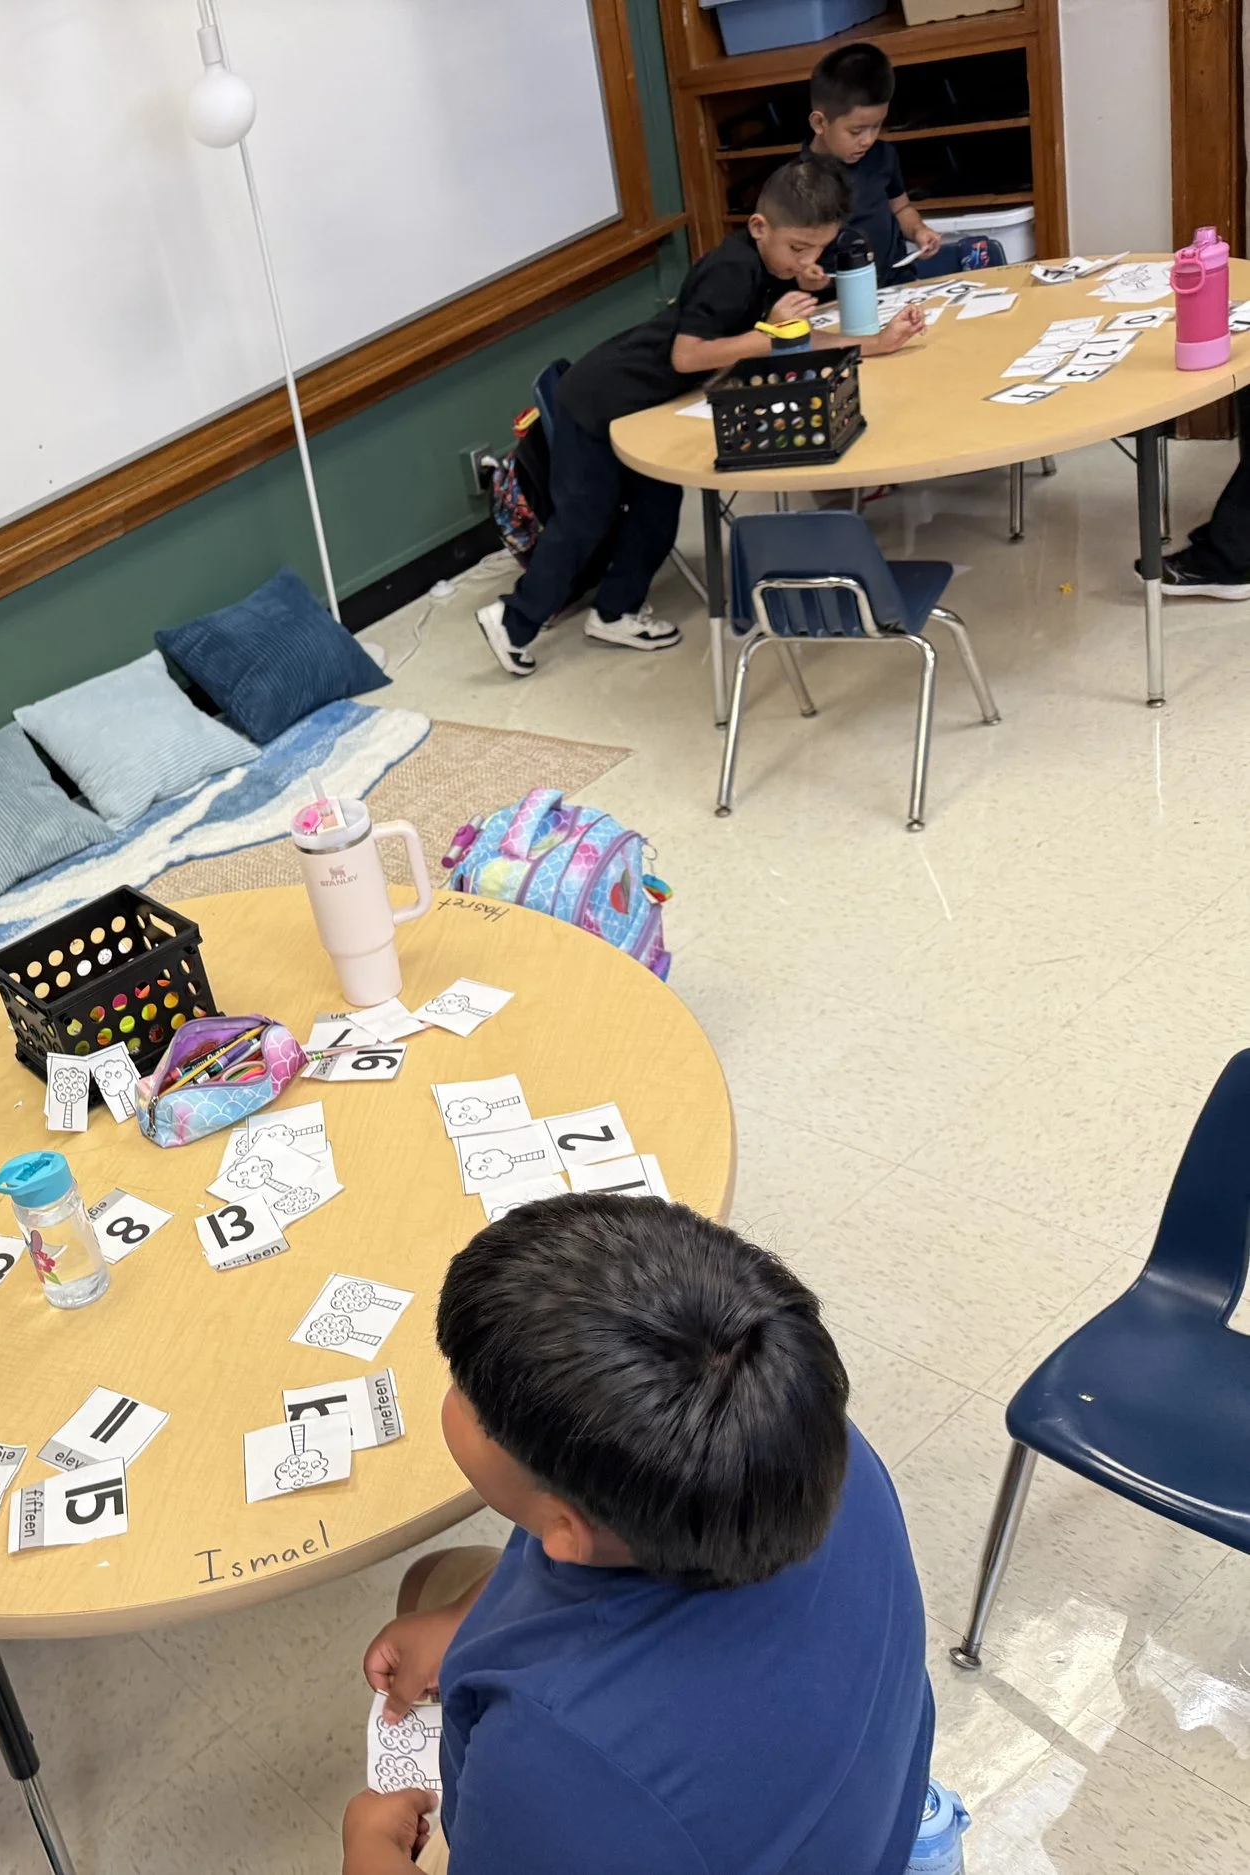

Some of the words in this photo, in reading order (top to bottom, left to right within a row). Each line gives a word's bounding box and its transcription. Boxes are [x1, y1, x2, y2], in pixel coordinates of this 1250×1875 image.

[1124, 314, 1157, 325] 0
[1083, 350, 1118, 359] 2
[1066, 369, 1100, 378] 3
[1010, 390, 1046, 399] 4
[320, 873, 358, 887] STANLEY
[350, 1048, 404, 1072] 16
[557, 1124, 616, 1152] 2
[106, 1216, 151, 1245] 8
[206, 1204, 255, 1250] 13
[89, 1396, 140, 1444] 11
[374, 1376, 396, 1438] nineteen
[54, 1448, 86, 1471] elev
[24, 1488, 44, 1538] fifteen
[64, 1476, 125, 1526] 15
[194, 1519, 330, 1584] Ismael
